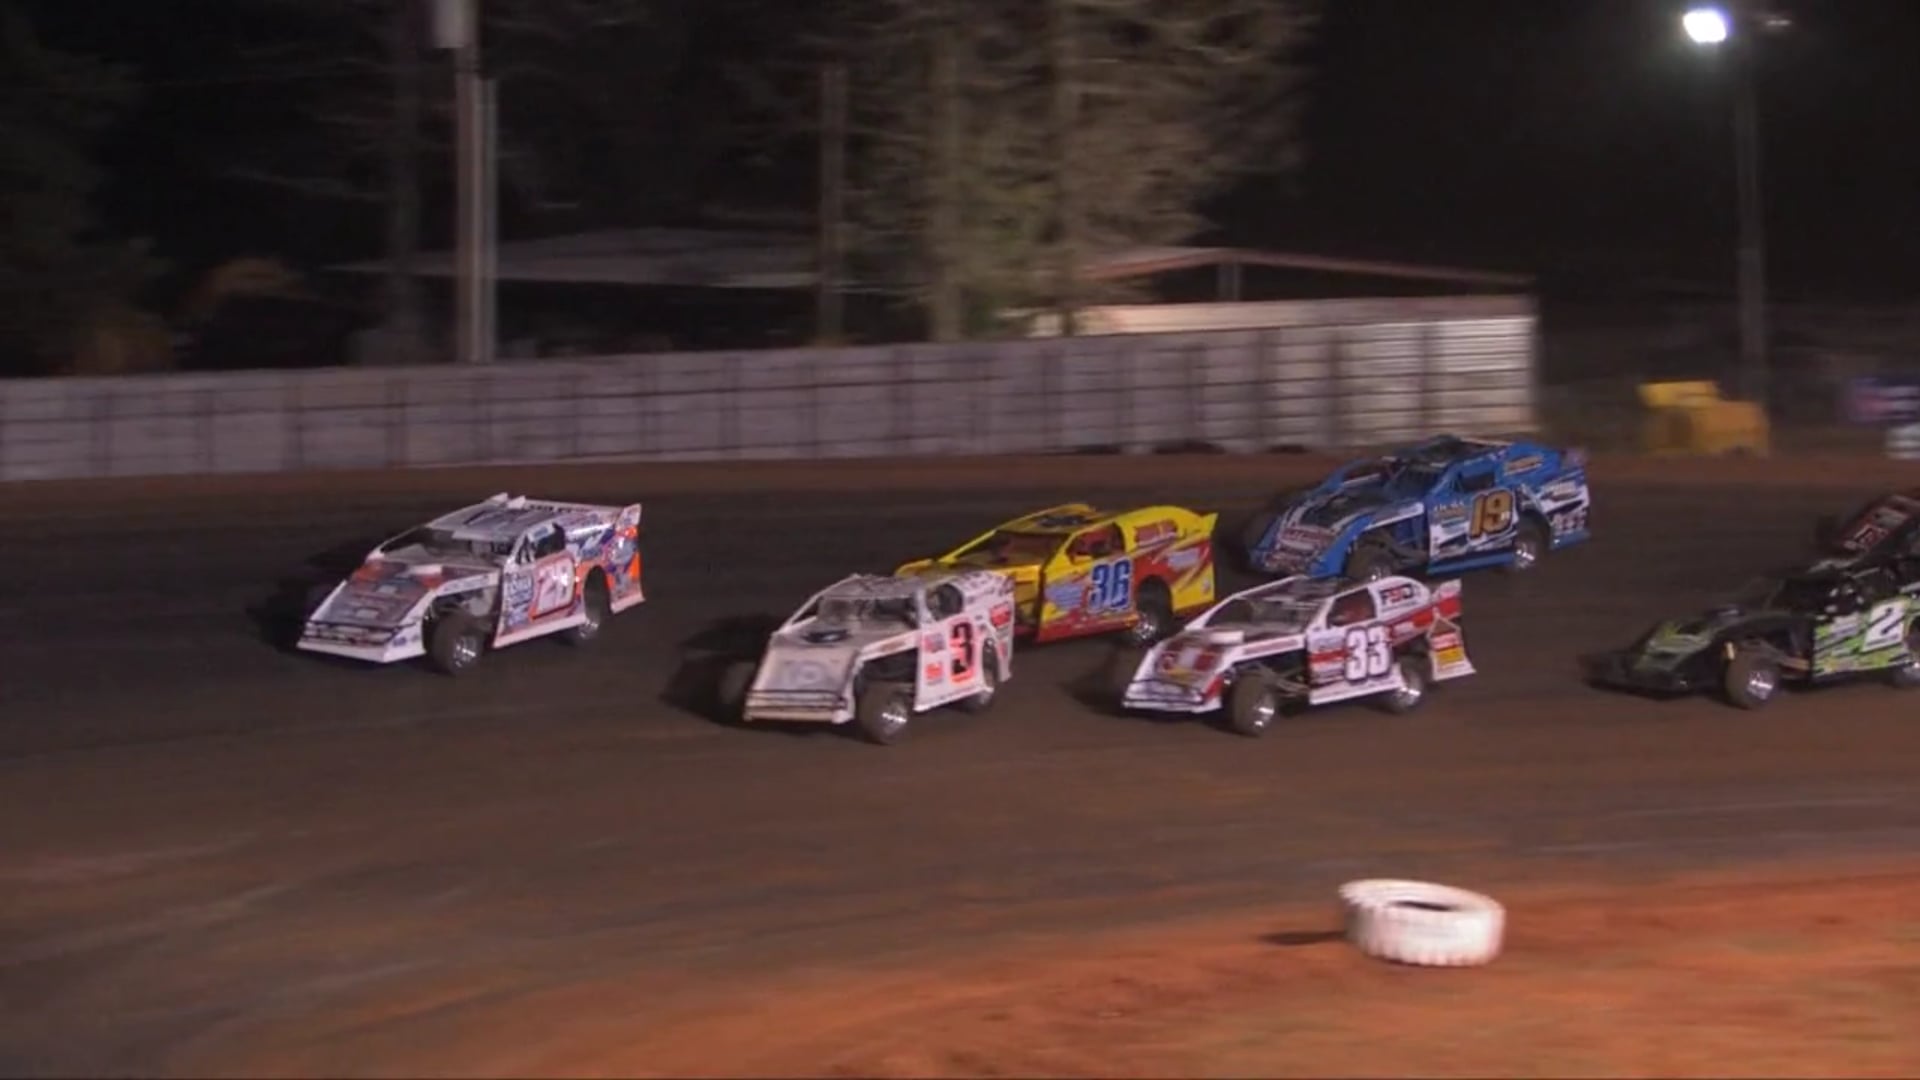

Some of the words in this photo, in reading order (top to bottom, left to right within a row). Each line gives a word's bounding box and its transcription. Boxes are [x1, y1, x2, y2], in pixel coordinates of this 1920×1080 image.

[1469, 488, 1514, 539] 19
[1088, 558, 1131, 613] 36
[949, 619, 976, 684] 3
[1345, 624, 1391, 683] 33
[1863, 601, 1905, 651] 2
